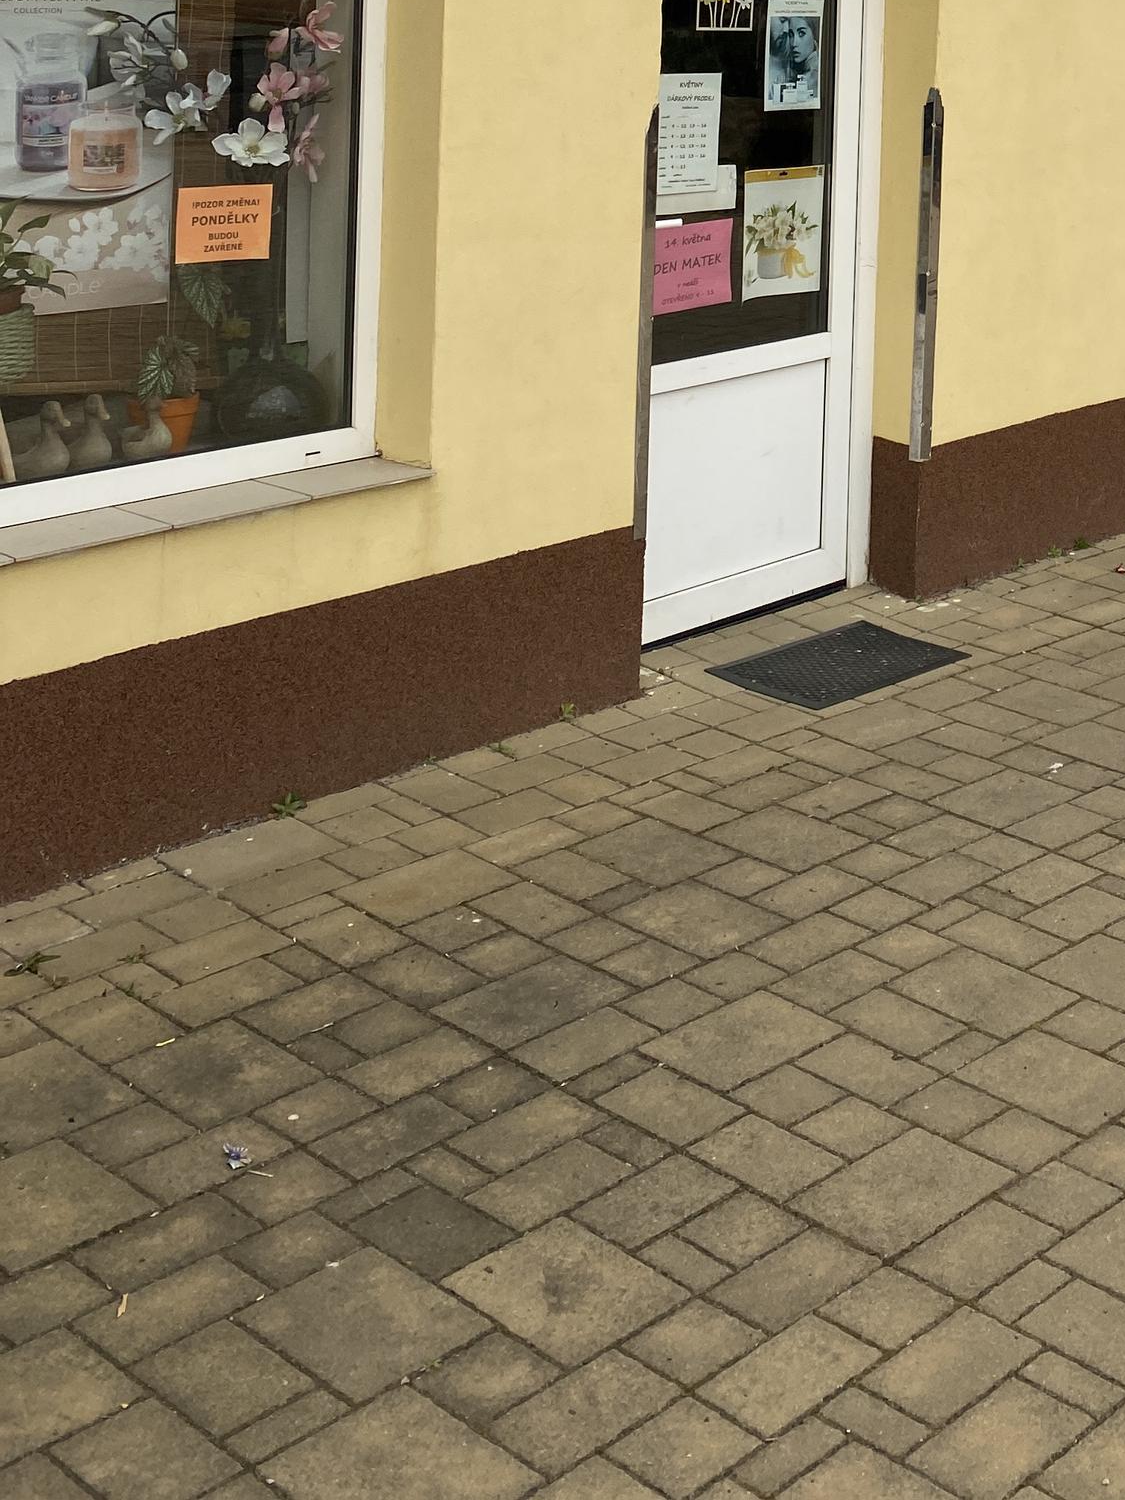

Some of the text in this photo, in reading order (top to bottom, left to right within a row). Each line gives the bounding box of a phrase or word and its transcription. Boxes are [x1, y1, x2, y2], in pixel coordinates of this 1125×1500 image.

[191, 211, 259, 227] PONDĚLKY
[208, 231, 239, 241] BUDOU
[682, 233, 712, 246] května
[653, 253, 722, 276] DEN MATEK
